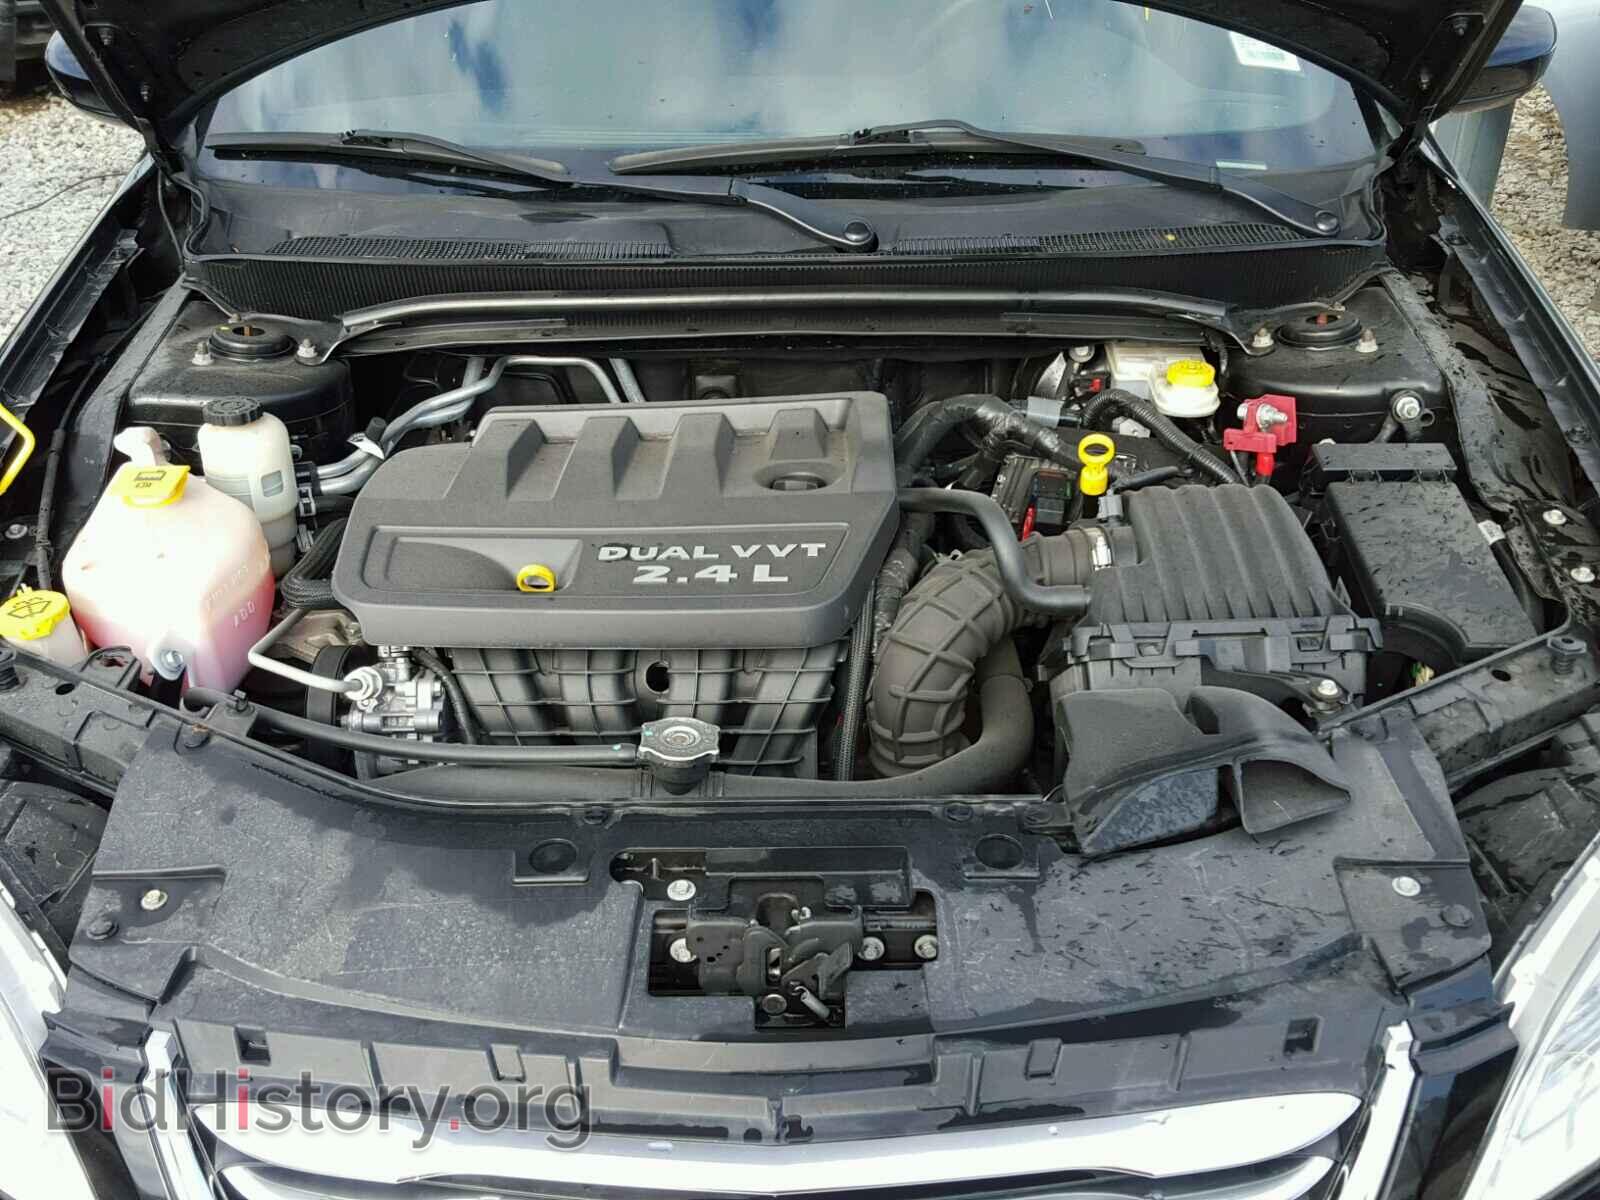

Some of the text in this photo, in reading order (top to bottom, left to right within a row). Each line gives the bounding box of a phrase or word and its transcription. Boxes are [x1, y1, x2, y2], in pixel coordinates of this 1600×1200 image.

[597, 543, 827, 561] DUAL VVT
[632, 563, 790, 584] 2.4 L
